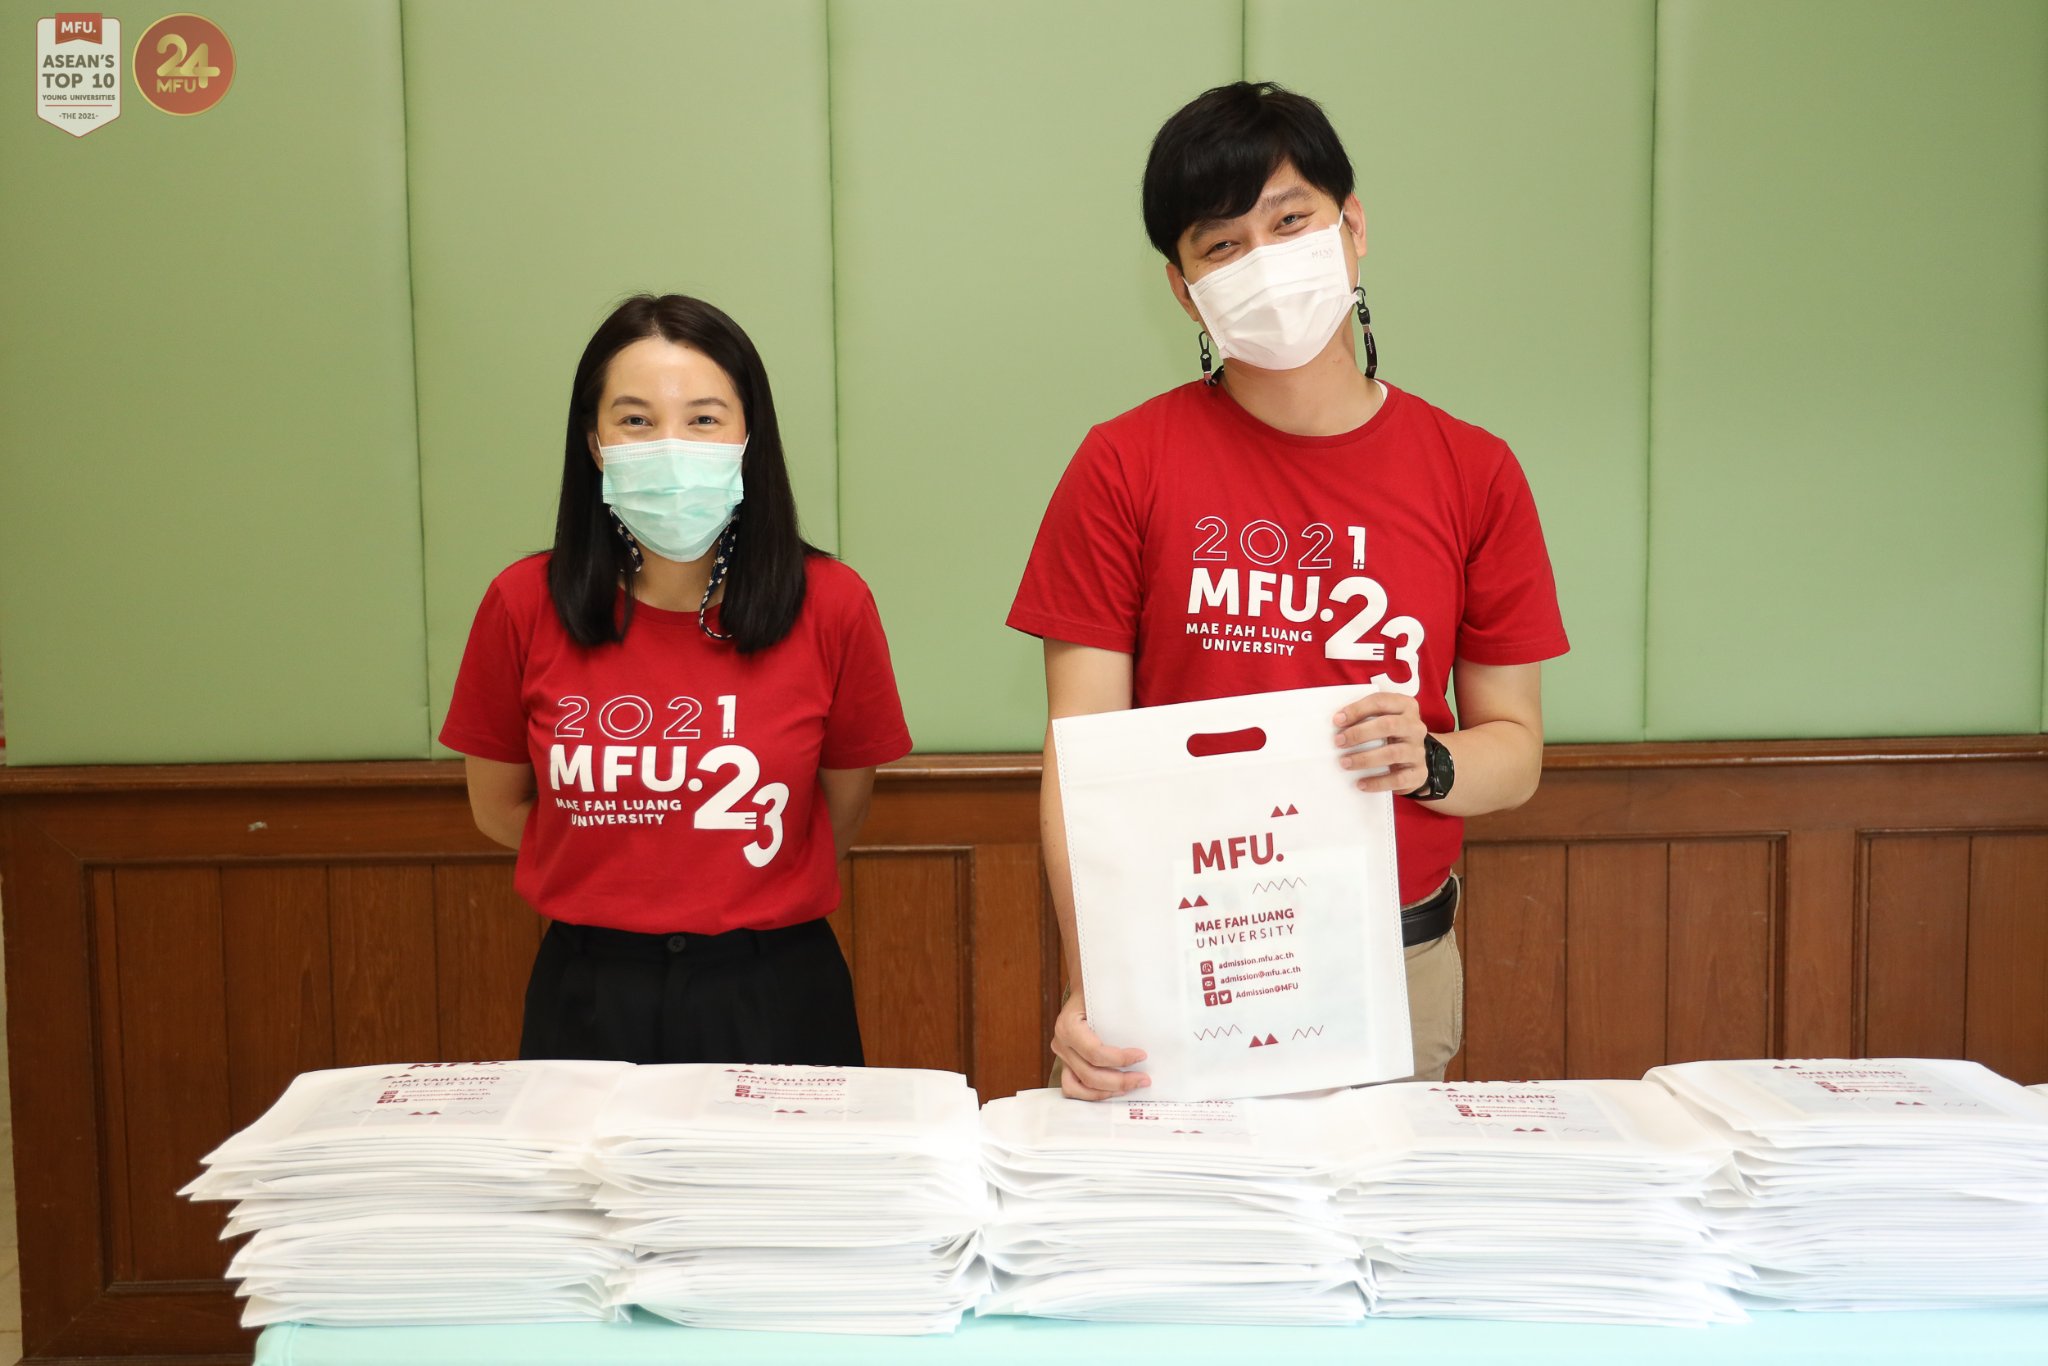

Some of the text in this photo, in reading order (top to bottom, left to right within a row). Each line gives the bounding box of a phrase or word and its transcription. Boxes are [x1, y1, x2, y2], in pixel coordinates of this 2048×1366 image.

[1192, 515, 1366, 570] 2021
[1185, 622, 1313, 642] MAE FAH LUANG
[1202, 637, 1295, 657] UNIVERSITY
[554, 694, 737, 741] 2021
[555, 797, 682, 812] MAE FAH LUANG
[571, 813, 665, 827] UNIVERSITY
[1192, 832, 1285, 874] MFU.
[1194, 908, 1295, 933] MAE FAH LUANG
[1196, 924, 1295, 949] UNIVERSITY
[1218, 951, 1295, 969] admission.mfu.ac.th
[1220, 966, 1301, 984] admission@mfu.ac.th
[1236, 982, 1299, 999] Admission@MFU
